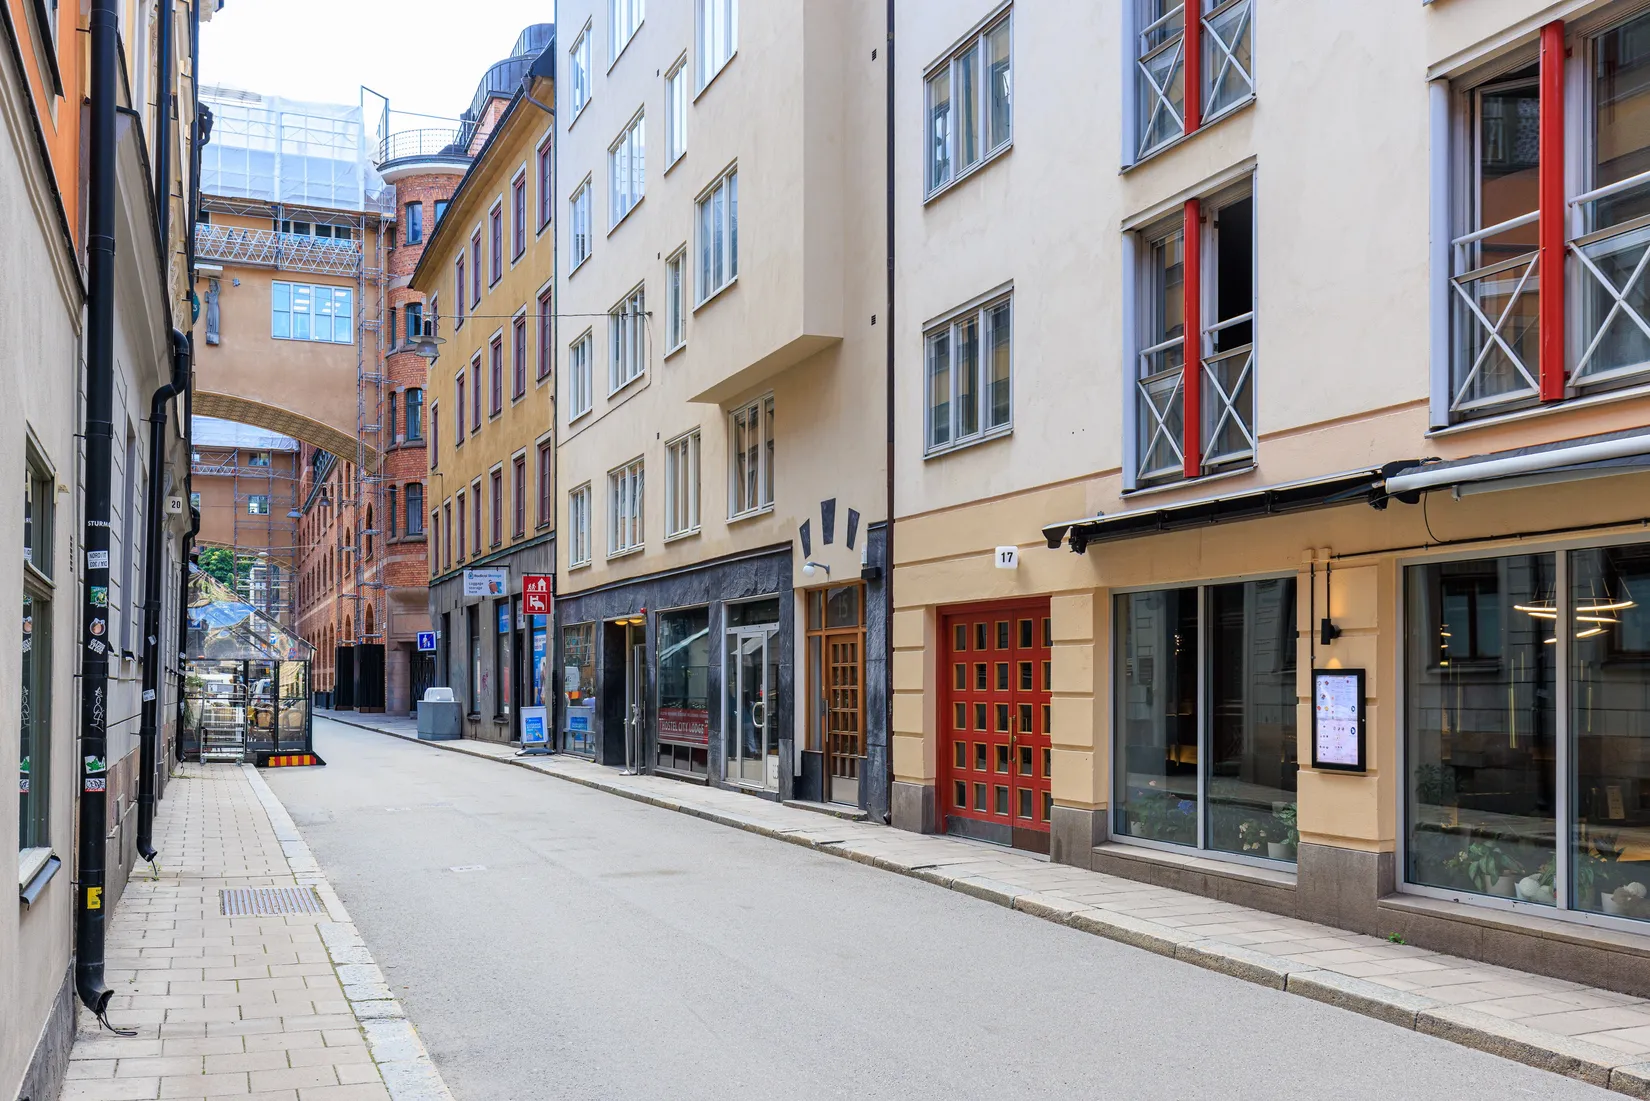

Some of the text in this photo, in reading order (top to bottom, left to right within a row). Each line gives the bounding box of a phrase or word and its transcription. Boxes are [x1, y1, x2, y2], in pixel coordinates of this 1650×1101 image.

[171, 500, 181, 509] 20
[1001, 551, 1014, 563] 17
[661, 720, 678, 732] HOSTEL
[678, 721, 689, 732] CITY
